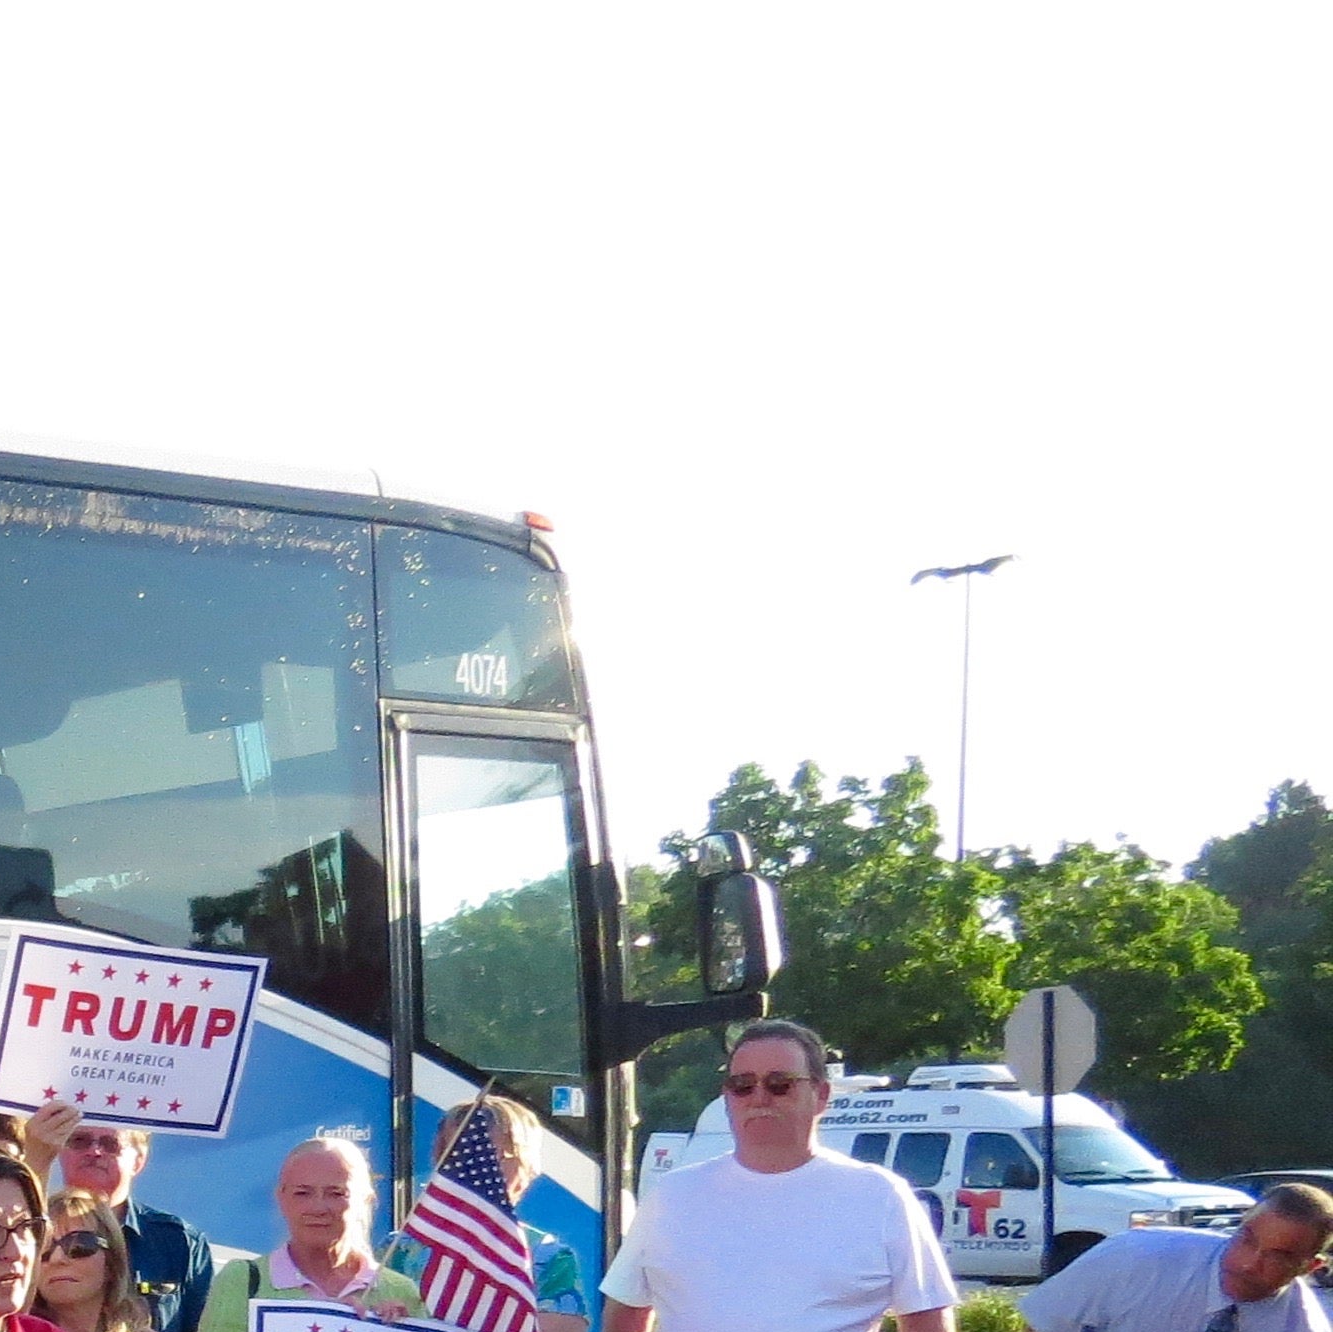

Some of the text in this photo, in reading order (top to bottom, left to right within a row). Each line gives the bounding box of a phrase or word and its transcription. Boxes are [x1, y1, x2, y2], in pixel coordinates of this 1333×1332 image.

[457, 653, 507, 696] 4074
[23, 984, 236, 1049] TRUMP
[70, 1046, 174, 1069] MAKE AMERICA
[70, 1066, 166, 1086] GREAT AGAIN!
[994, 1218, 1026, 1239] 62
